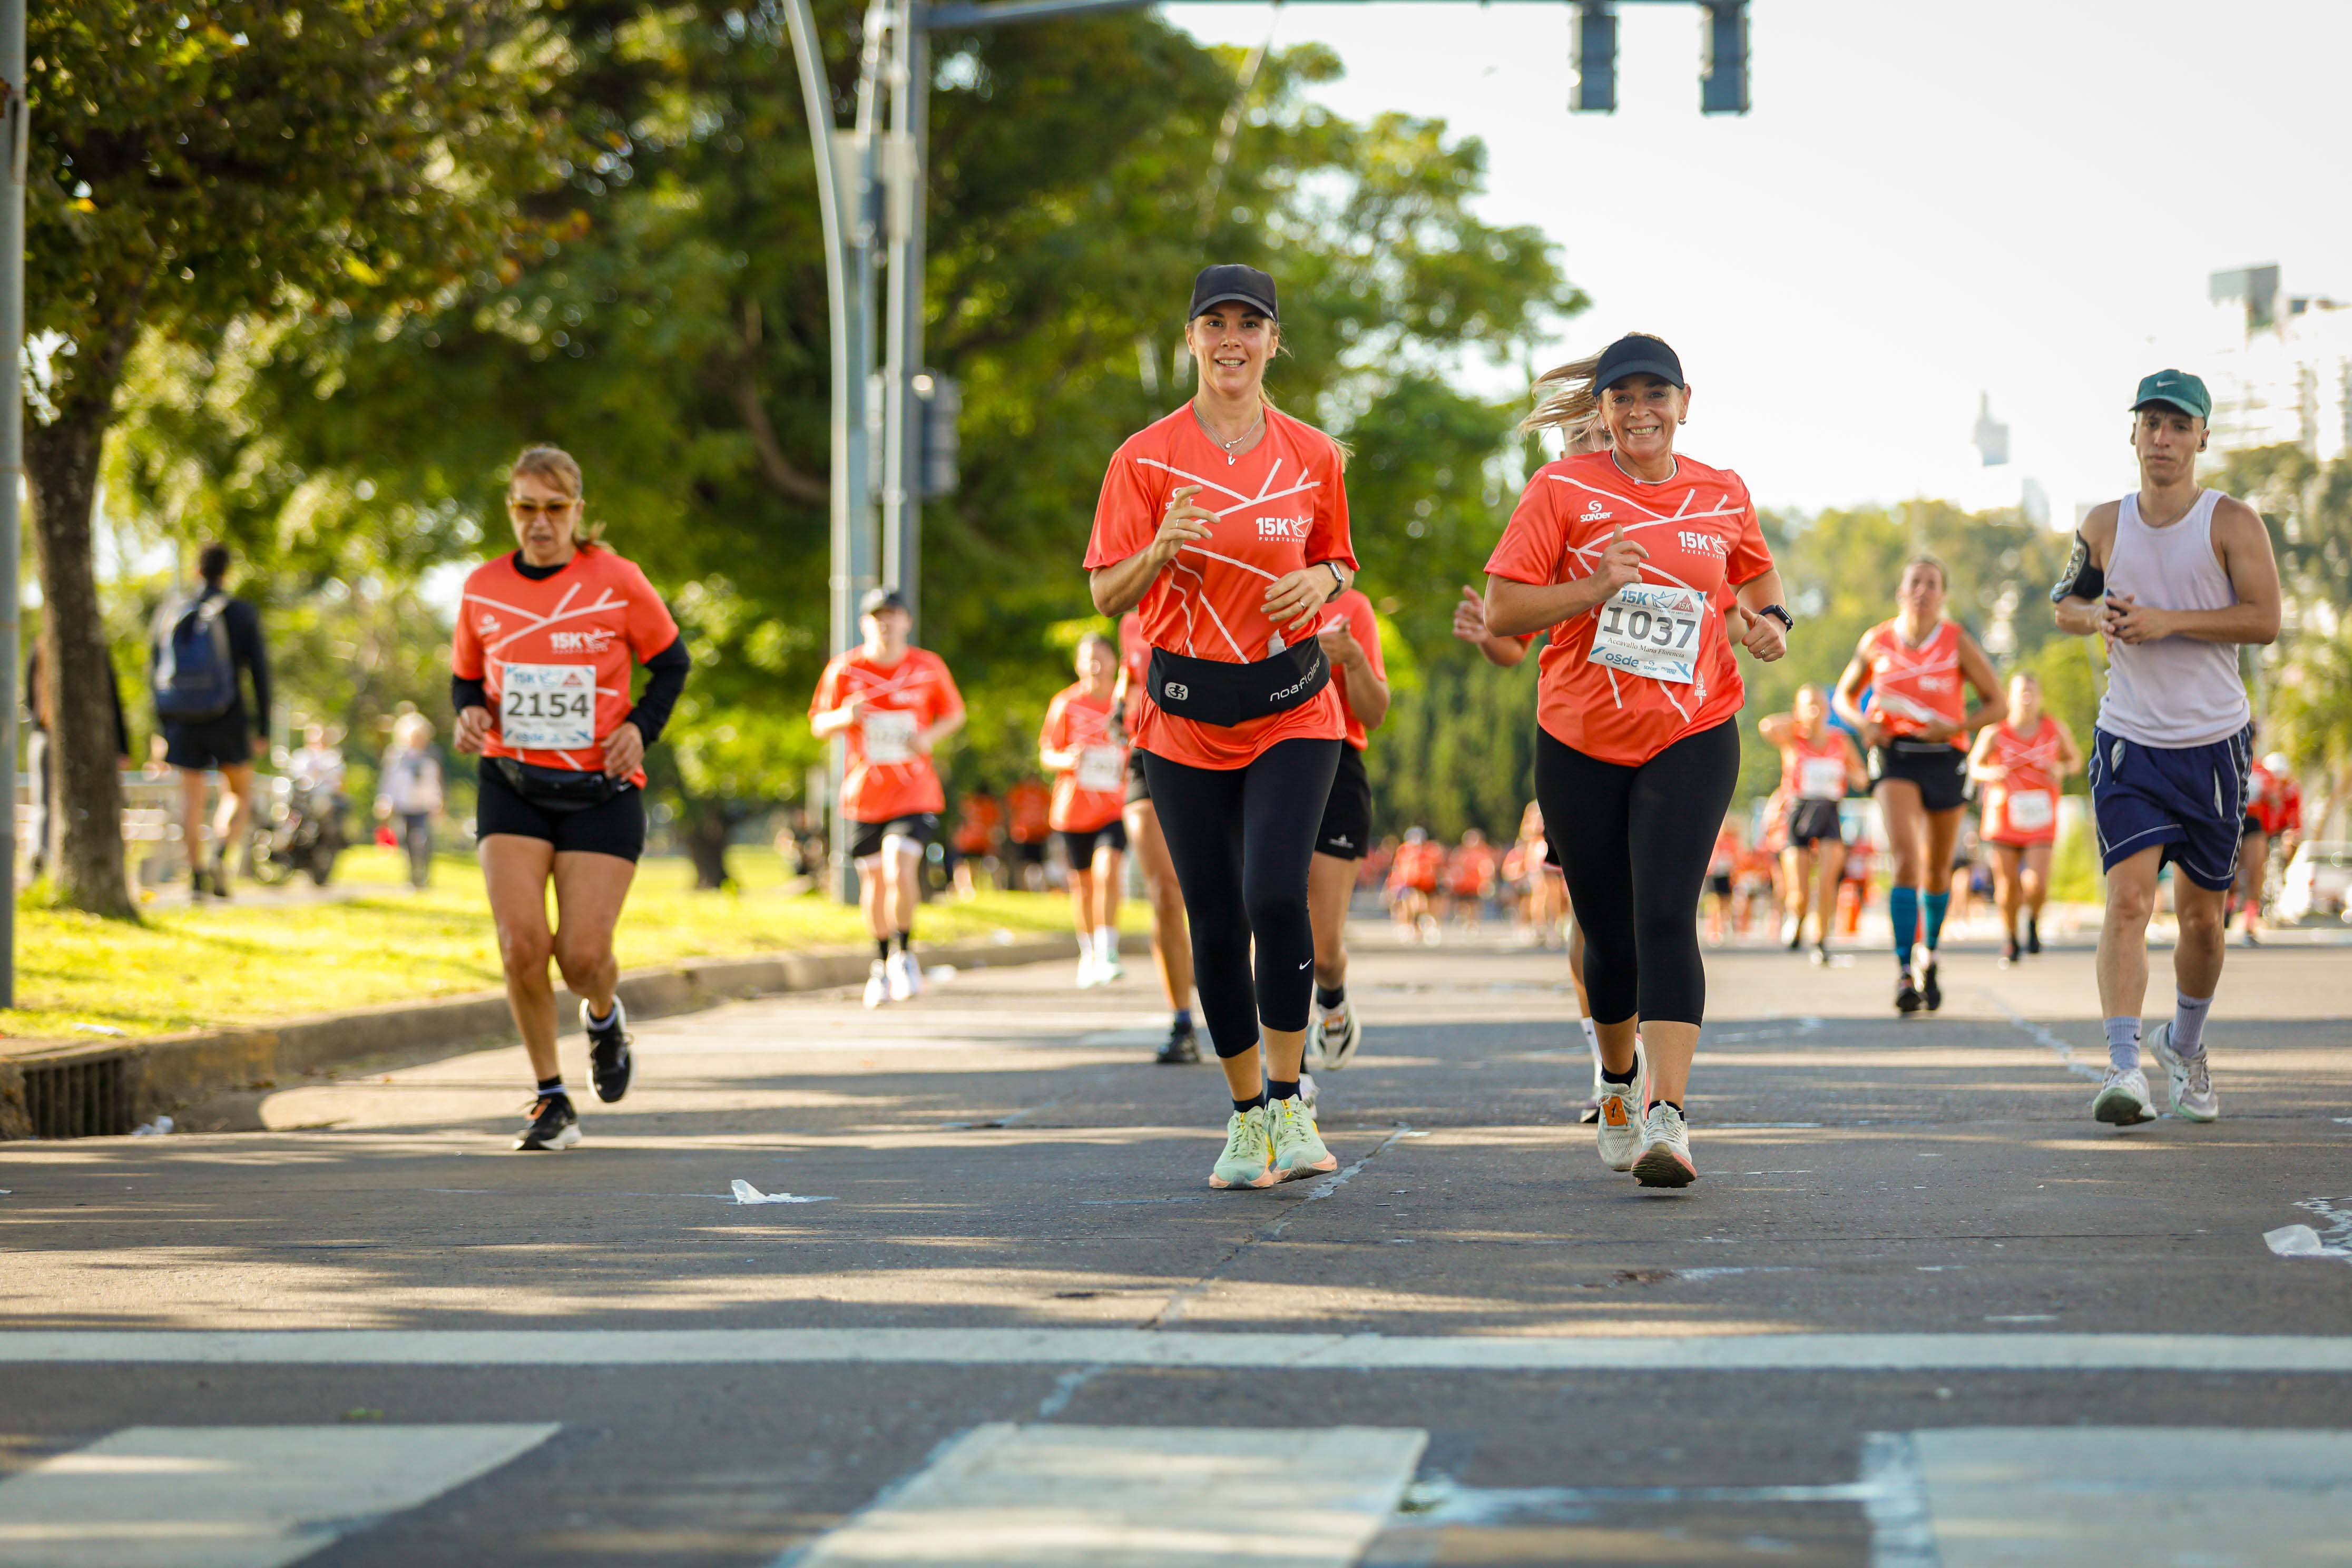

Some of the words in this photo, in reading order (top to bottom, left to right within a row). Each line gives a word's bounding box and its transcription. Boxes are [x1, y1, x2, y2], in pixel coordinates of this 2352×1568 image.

[1256, 517, 1290, 535] 15K
[1678, 531, 1710, 551] 15K
[1621, 590, 1649, 606] 15K
[1603, 607, 1696, 649] 1037
[1608, 637, 1638, 650] Accavallo
[1658, 648, 1685, 658] Florencia
[1605, 653, 1639, 668] osde
[507, 691, 590, 718] 2154
